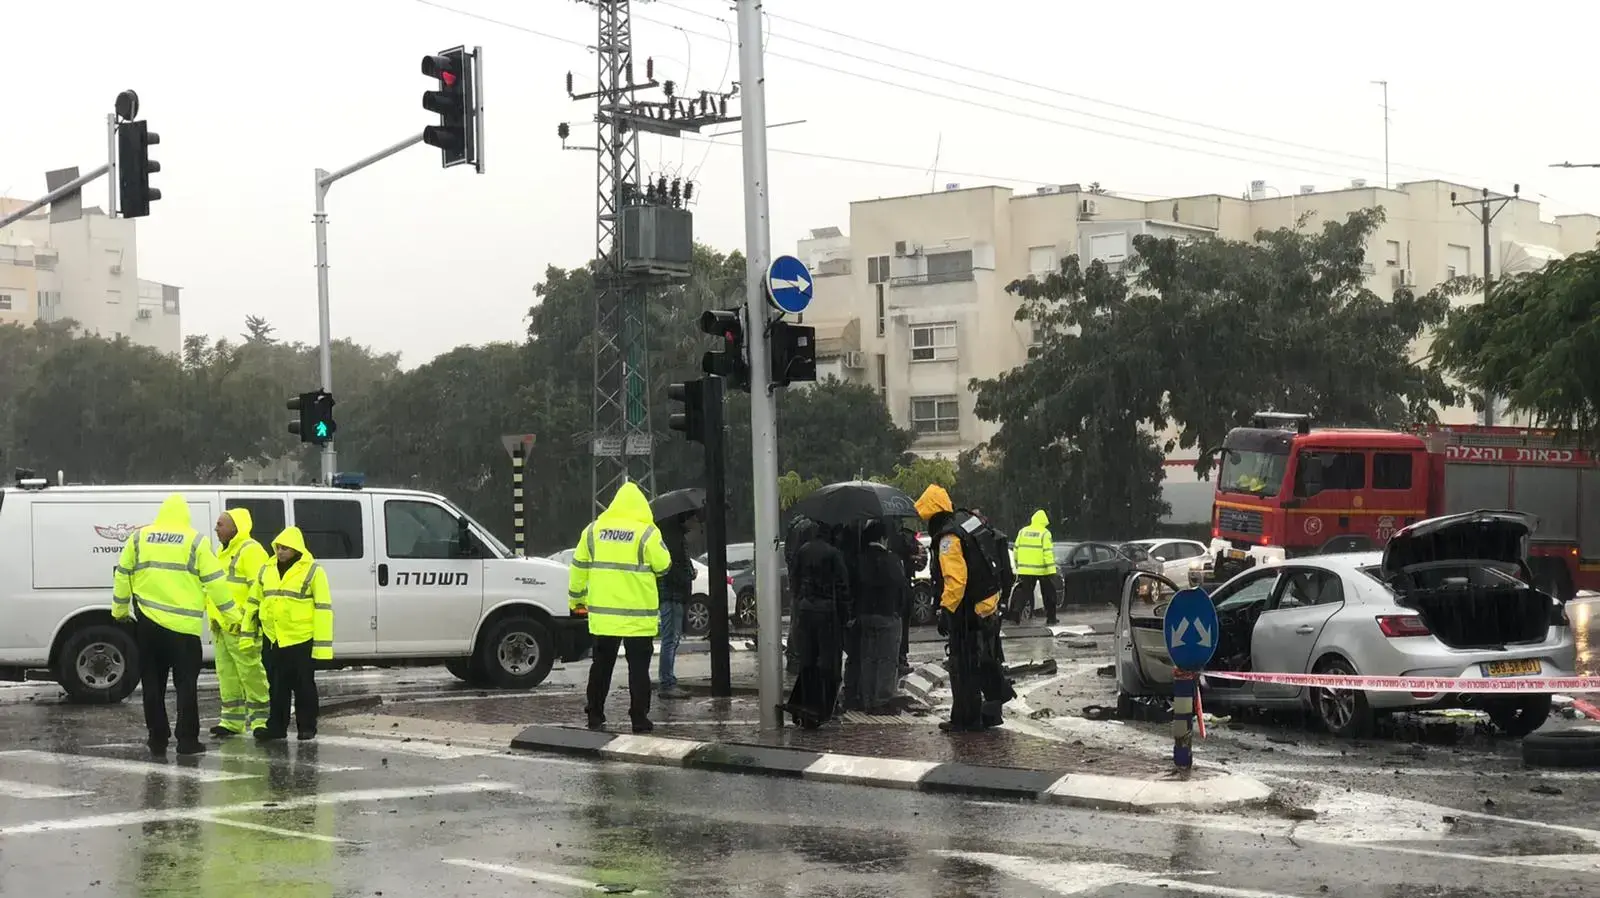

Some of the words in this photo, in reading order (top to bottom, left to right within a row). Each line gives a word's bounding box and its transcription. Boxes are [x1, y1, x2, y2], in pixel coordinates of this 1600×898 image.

[1446, 445, 1503, 460] והצלה
[1516, 448, 1573, 462] כבאות
[146, 532, 184, 544] משטרה
[600, 529, 634, 542] משטרה
[396, 572, 469, 586] משטרה
